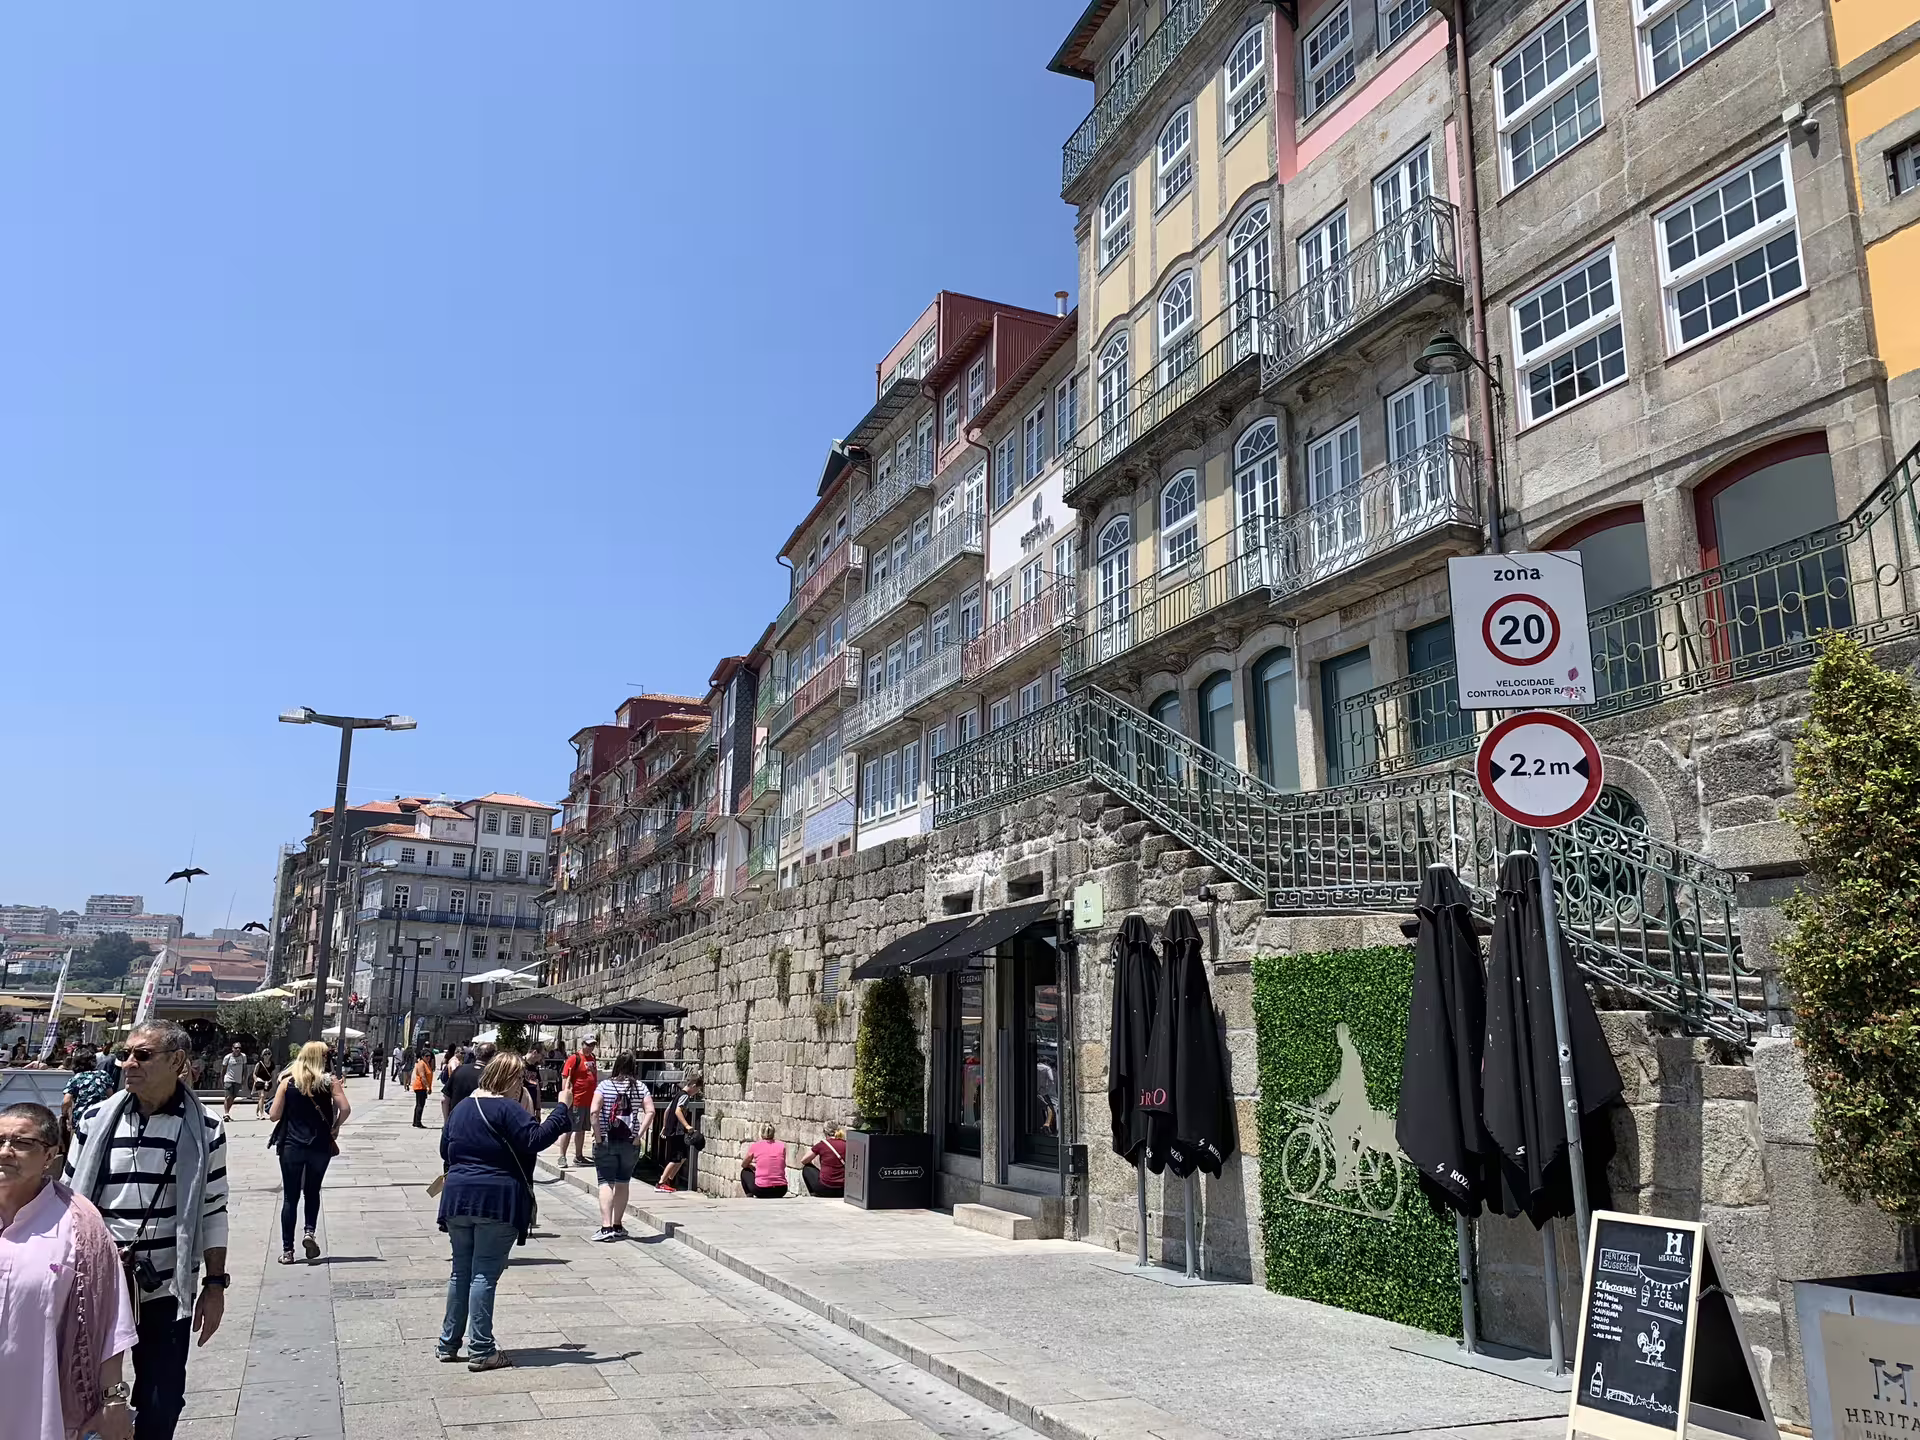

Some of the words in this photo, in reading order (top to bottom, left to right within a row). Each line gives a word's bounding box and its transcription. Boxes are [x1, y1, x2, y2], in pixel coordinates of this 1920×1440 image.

[1493, 567, 1542, 582] zona
[1498, 614, 1545, 646] 20
[1496, 678, 1555, 688] VELOCIDADE
[1467, 688, 1530, 698] CONTROLADA
[1532, 687, 1552, 696] POR
[1664, 1231, 1684, 1256] H
[1658, 1254, 1686, 1265] HERITAGE
[1653, 1289, 1673, 1300] ICE
[1658, 1299, 1684, 1312] CREAM
